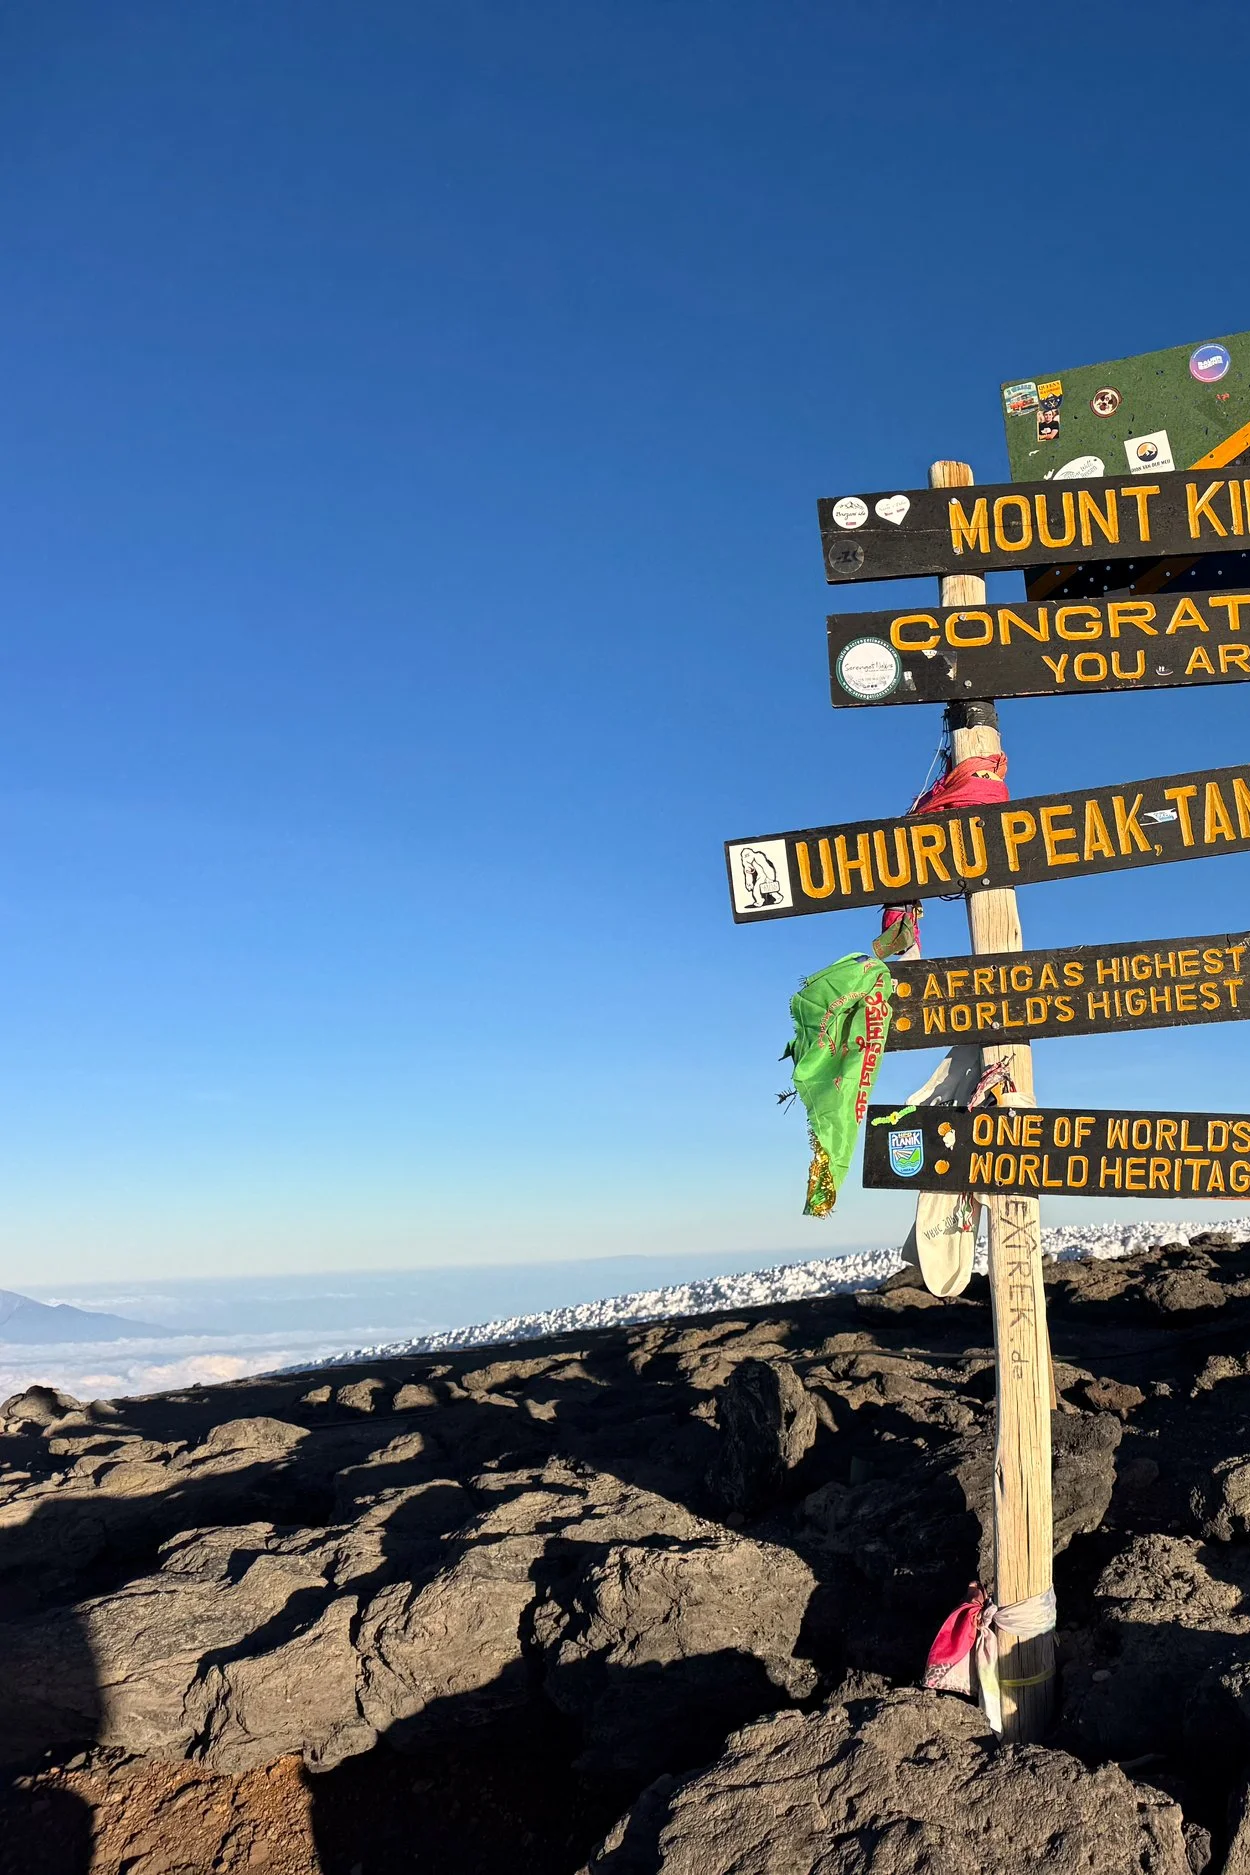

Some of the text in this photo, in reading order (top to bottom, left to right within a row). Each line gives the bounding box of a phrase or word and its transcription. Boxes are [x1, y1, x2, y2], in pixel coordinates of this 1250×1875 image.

[948, 484, 1161, 554] MOUNT
[1041, 649, 1146, 684] YOU
[796, 815, 989, 899] UHURU
[1097, 945, 1245, 987] HIGHEST
[922, 994, 1075, 1034] WORLD'S
[1088, 977, 1245, 1019] HIGHEST
[971, 1112, 1044, 1148] ONE
[1054, 1115, 1097, 1149] OF
[968, 1151, 1089, 1188] WORLD
